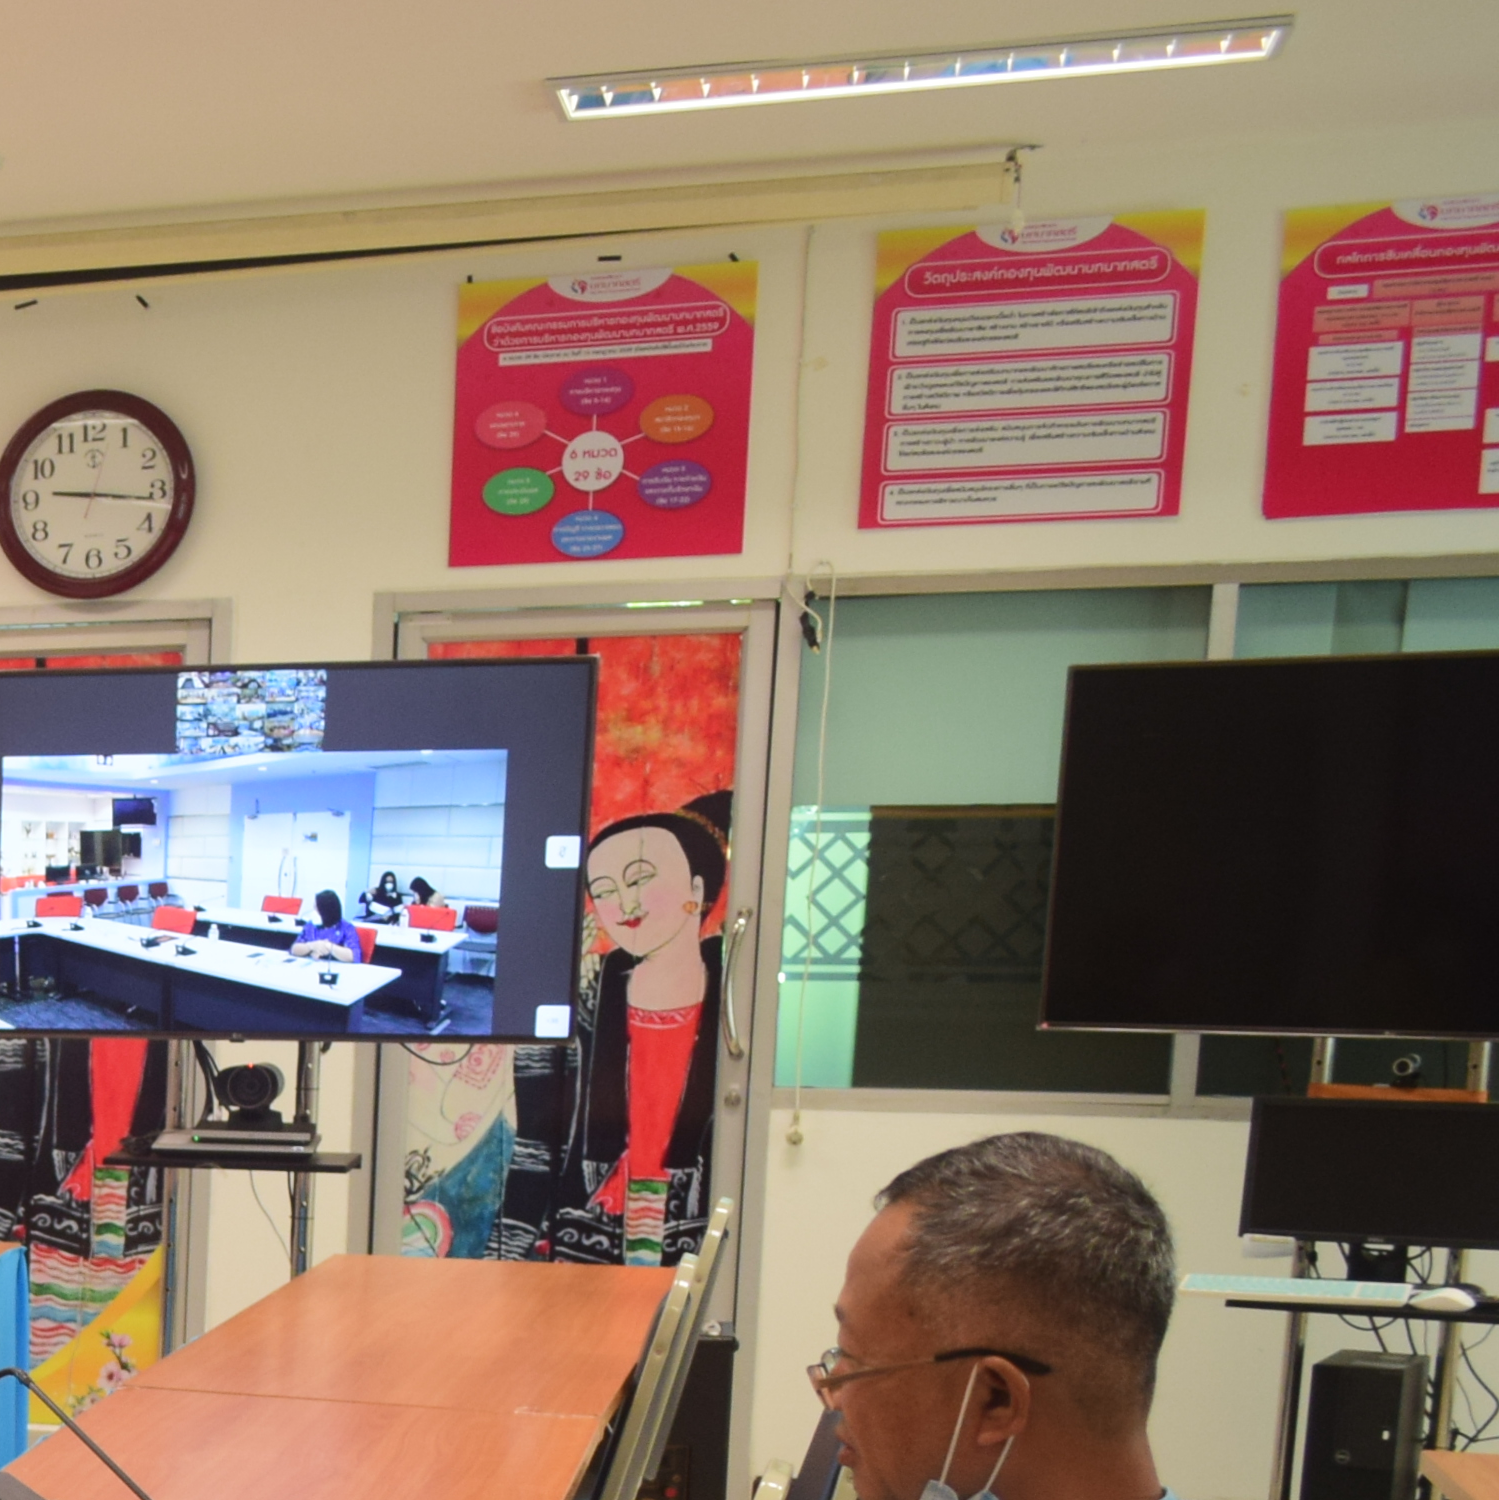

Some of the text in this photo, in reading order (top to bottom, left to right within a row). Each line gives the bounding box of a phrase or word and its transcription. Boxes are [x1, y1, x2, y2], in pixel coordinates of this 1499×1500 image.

[923, 255, 1159, 287] วัตถุประสงค์กองทุนพัฒนาบทบาทสตรี
[56, 432, 75, 455] 11
[81, 422, 107, 443] 12
[121, 427, 128, 448] 1
[140, 448, 156, 470] 2
[569, 447, 618, 460] 6 หมวด
[32, 458, 55, 480] 10
[573, 467, 612, 482] 29 ข้อ
[149, 479, 167, 499] 3
[22, 490, 40, 511] 9
[31, 519, 49, 541] 8
[137, 512, 154, 534] 4
[57, 543, 74, 565] 7
[84, 548, 103, 570] 6
[114, 538, 132, 560] 5
